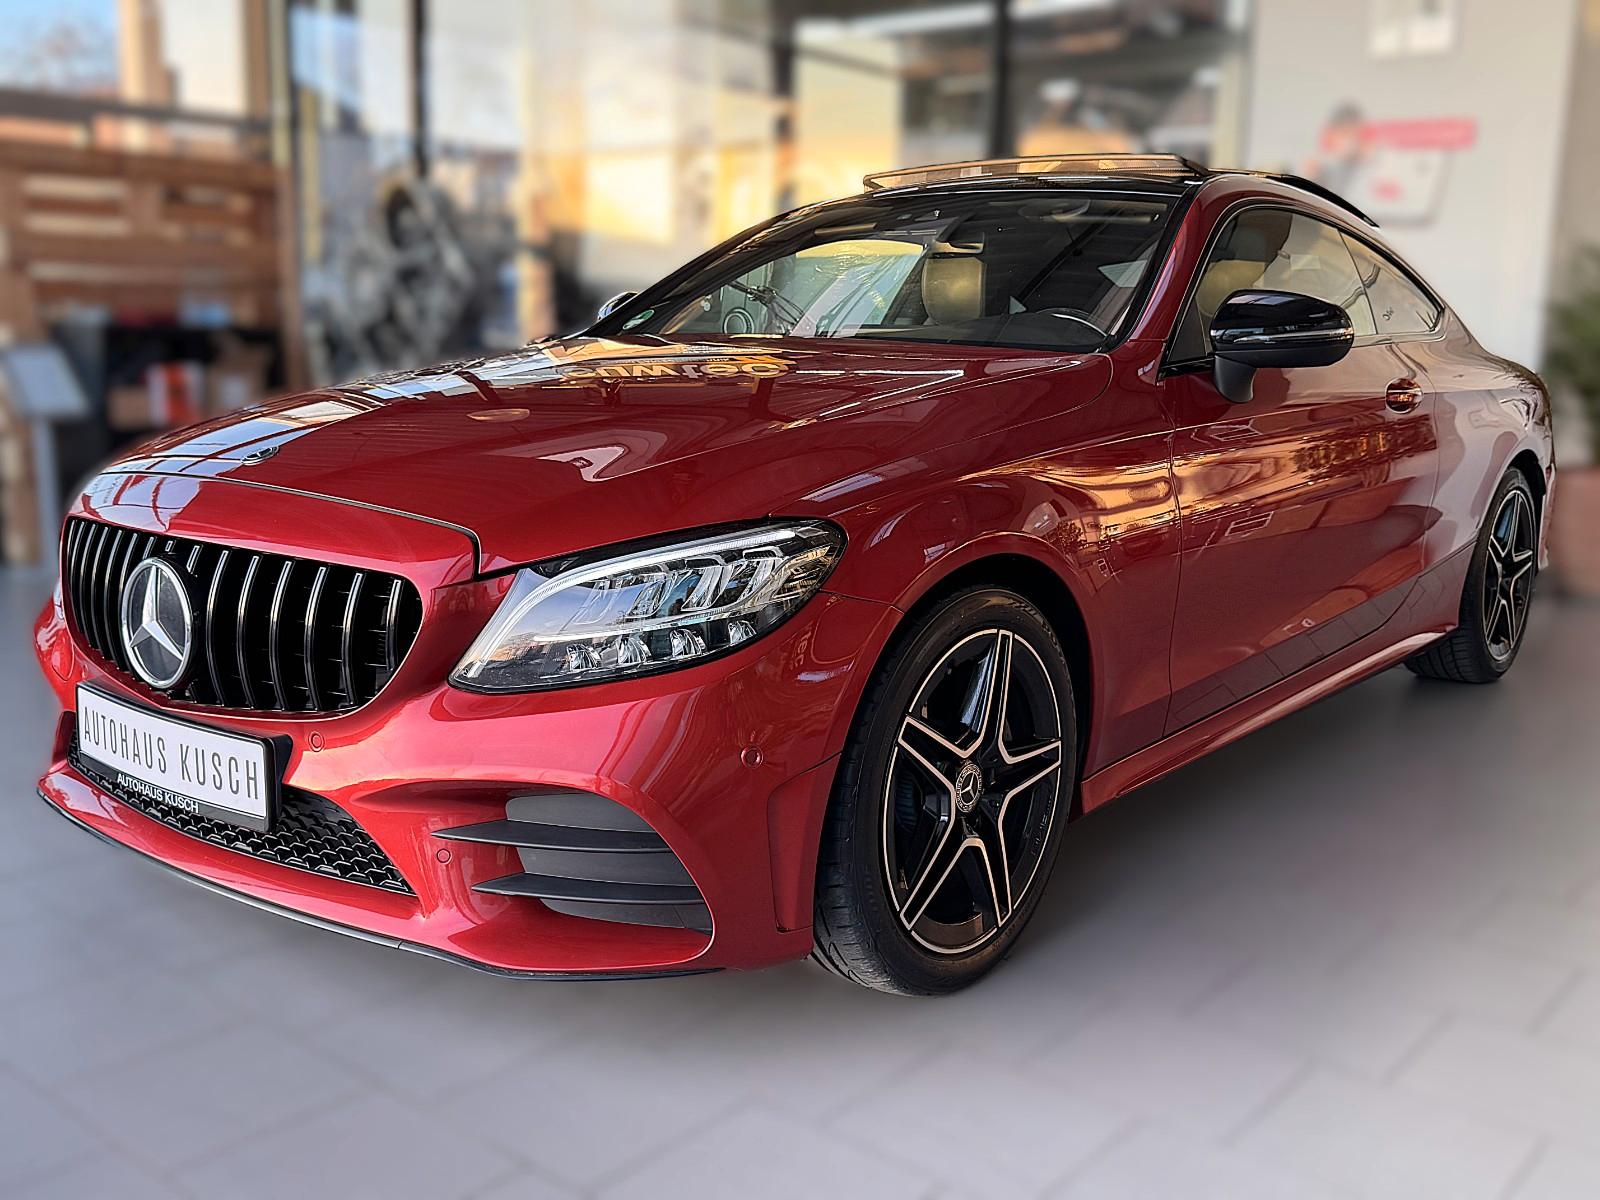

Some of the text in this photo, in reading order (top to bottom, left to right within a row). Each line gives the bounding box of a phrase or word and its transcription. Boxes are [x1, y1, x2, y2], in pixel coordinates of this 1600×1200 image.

[84, 706, 259, 800] AUTOHAUS KUSCH
[117, 773, 199, 813] AUTOHAUS KUSCH
